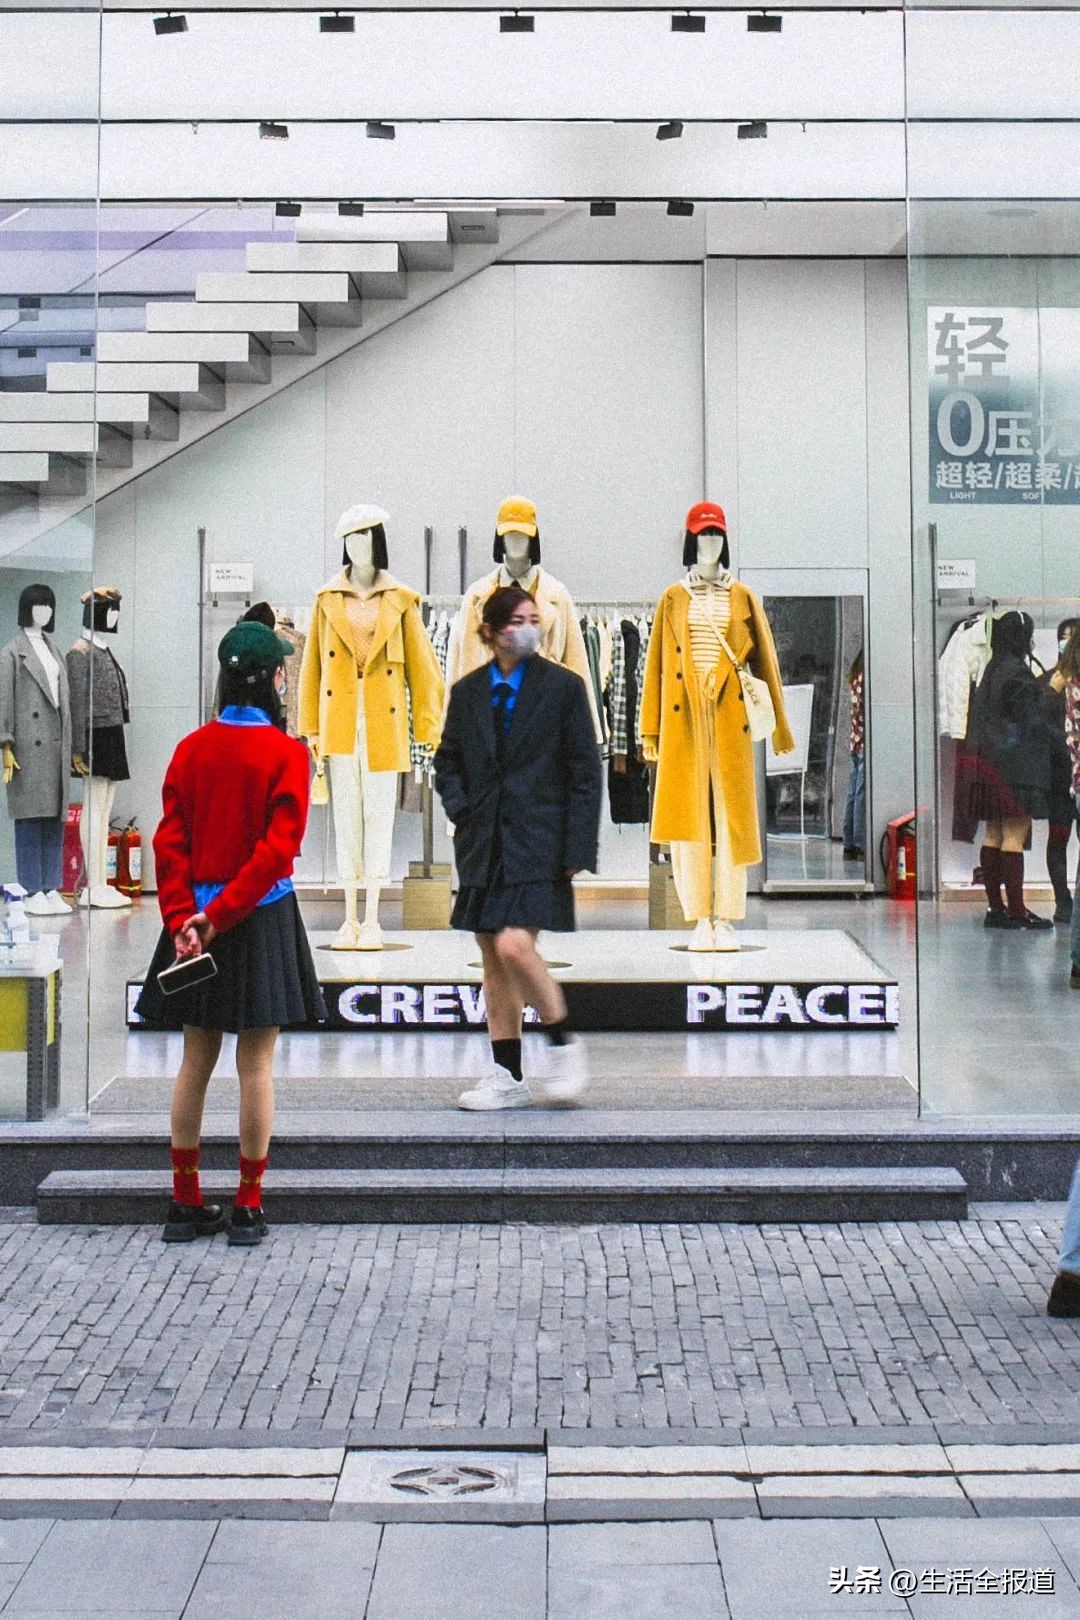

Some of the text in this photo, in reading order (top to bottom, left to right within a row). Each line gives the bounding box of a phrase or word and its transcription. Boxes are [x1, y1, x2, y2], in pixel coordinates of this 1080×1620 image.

[935, 312, 1010, 386] 轻
[937, 391, 1080, 457] 0压
[936, 461, 1080, 490] 超轻/超柔/
[949, 491, 977, 500] LIGHT
